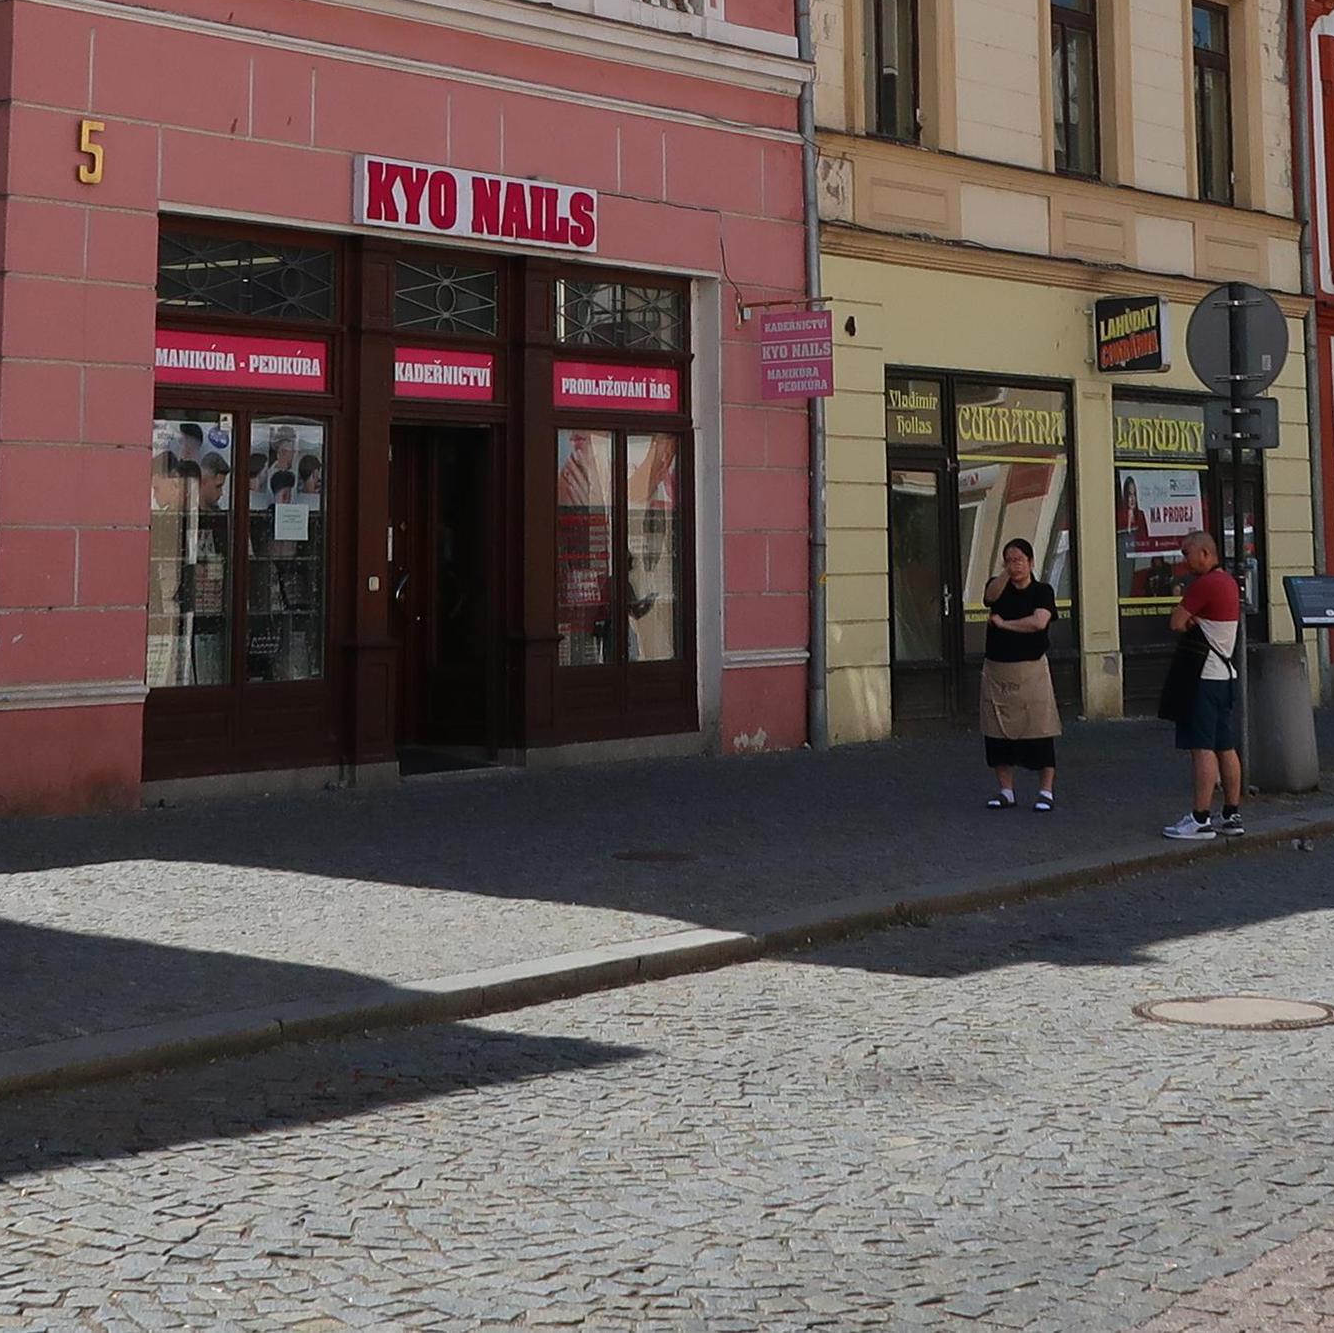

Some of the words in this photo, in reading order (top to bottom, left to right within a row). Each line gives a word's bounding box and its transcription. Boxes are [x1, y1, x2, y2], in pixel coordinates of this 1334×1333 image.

[79, 119, 105, 184] 5
[366, 160, 458, 230] KYO
[471, 176, 596, 247] NAILS
[1099, 303, 1158, 342] LAHŮDKY
[154, 343, 236, 372] MANIKÚRA
[249, 349, 322, 377] PEDIKÚRA
[762, 345, 787, 360] KYO
[792, 342, 831, 358] NAILS
[394, 359, 493, 388] KADEŘNICTVÍ
[561, 374, 647, 399] PRODLUŽOVÁNÍ
[649, 377, 672, 399] ŘAS
[958, 400, 1065, 446] CUKRÁRNA
[1150, 506, 1162, 524] NA
[1163, 505, 1194, 524] PRODEJ
